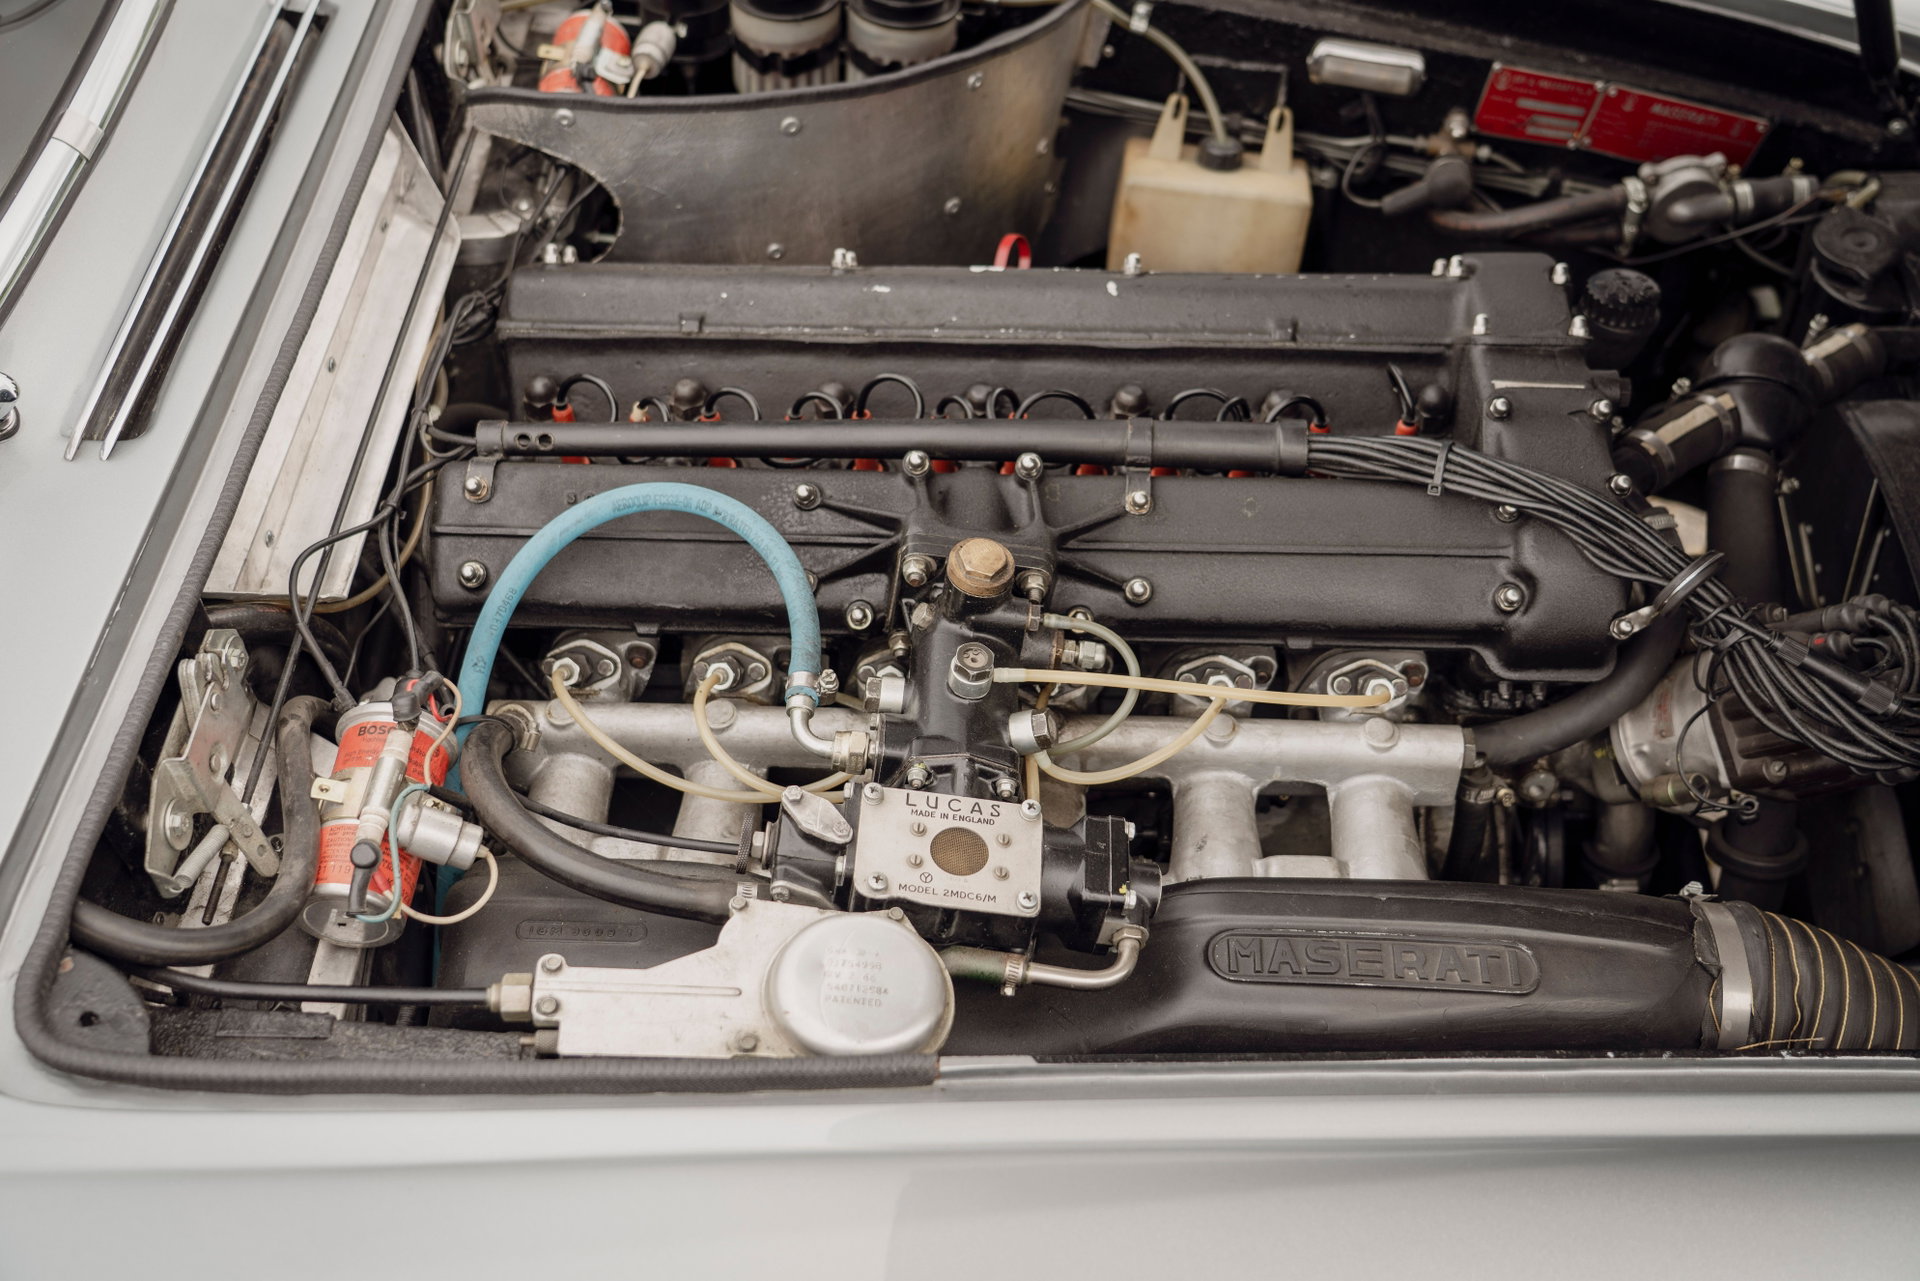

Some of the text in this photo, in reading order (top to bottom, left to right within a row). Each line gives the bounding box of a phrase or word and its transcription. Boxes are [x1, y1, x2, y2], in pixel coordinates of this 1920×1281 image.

[906, 793, 1001, 818] LUCAS
[911, 808, 996, 826] MADE IN ENGLAND
[898, 882, 997, 904] MODEL 2MDC6/M
[1227, 936, 1522, 987] MASERATI
